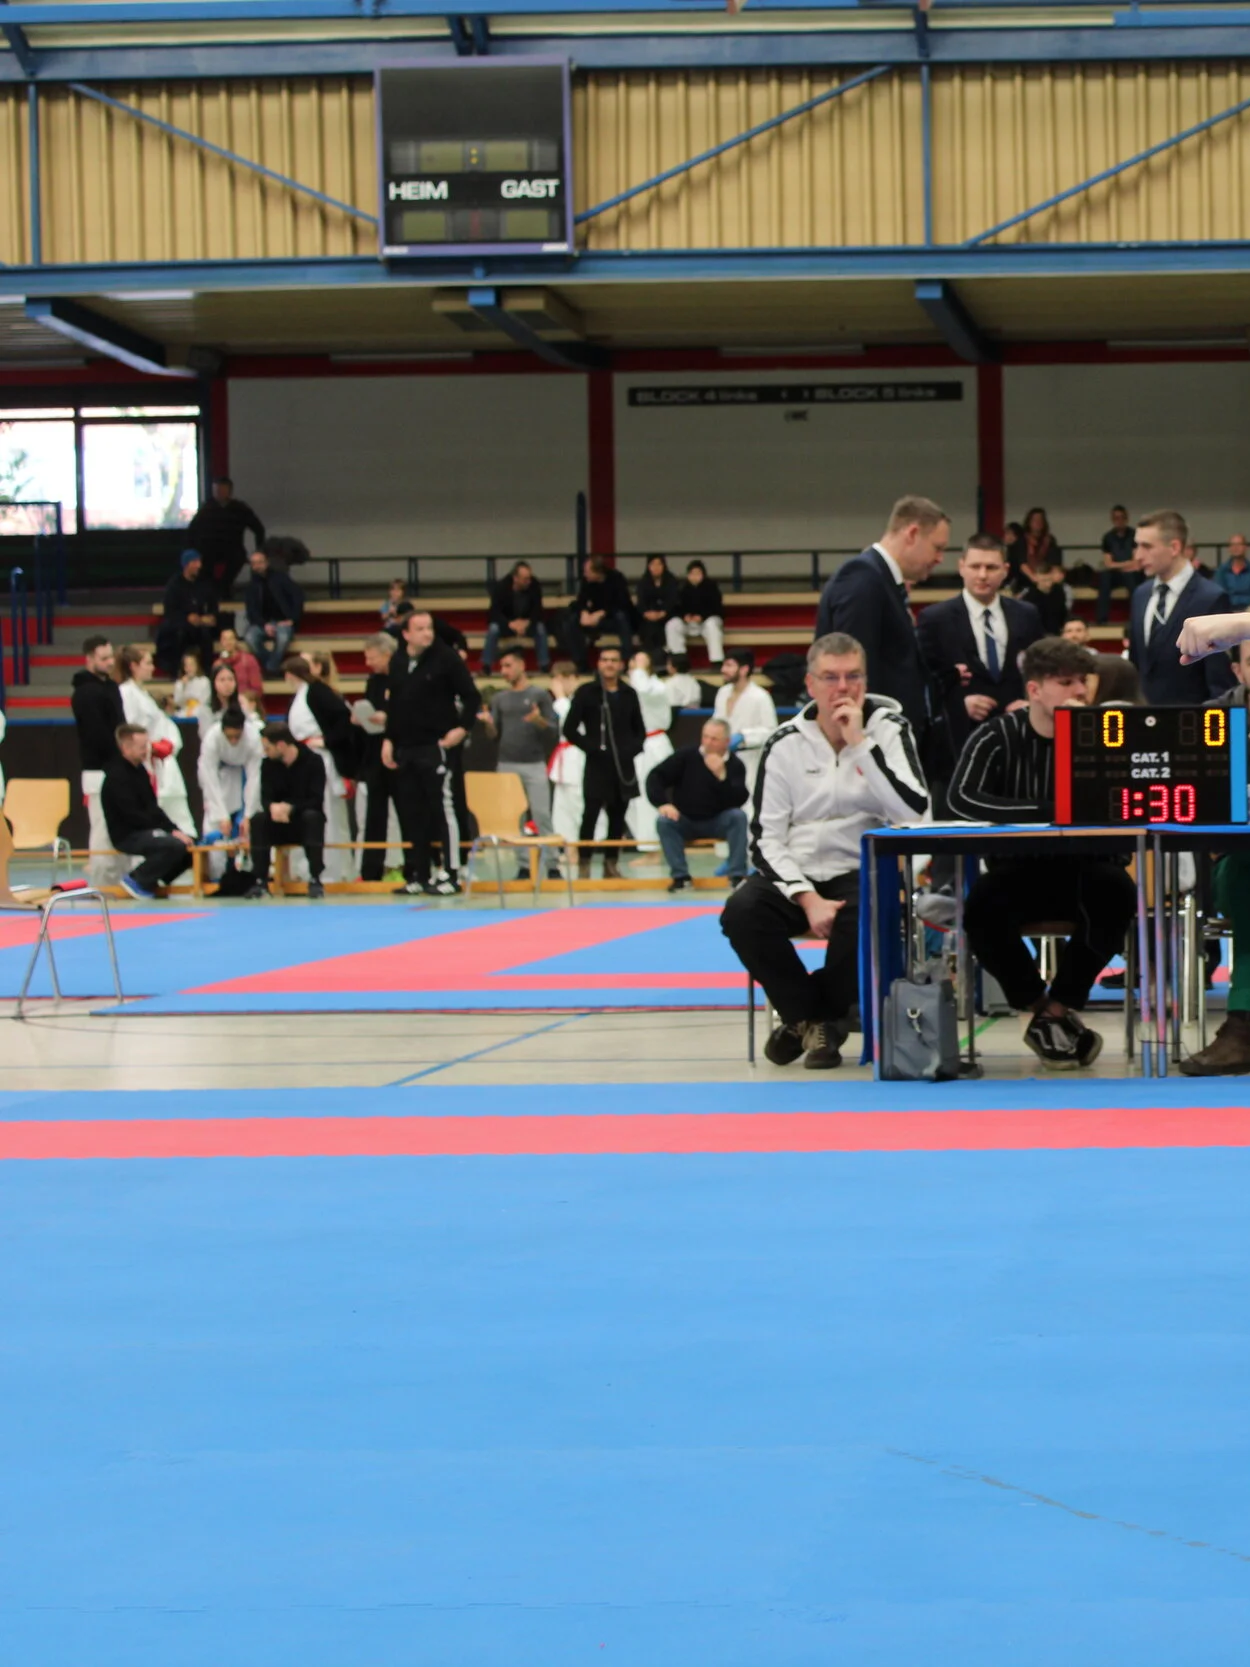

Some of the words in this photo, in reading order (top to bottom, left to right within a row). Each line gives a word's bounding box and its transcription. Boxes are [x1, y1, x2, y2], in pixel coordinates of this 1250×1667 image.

[388, 180, 449, 201] HEIM
[500, 178, 560, 199] GAST
[636, 390, 699, 402] BLOCK
[814, 387, 878, 400] BLOCK
[1103, 710, 1124, 747] 0
[1204, 709, 1225, 746] 0
[1130, 752, 1160, 764] CAT.
[1161, 751, 1170, 763] 1
[1130, 768, 1160, 779] CAT.
[1161, 767, 1171, 779] 2
[1121, 784, 1196, 823] 1:30
